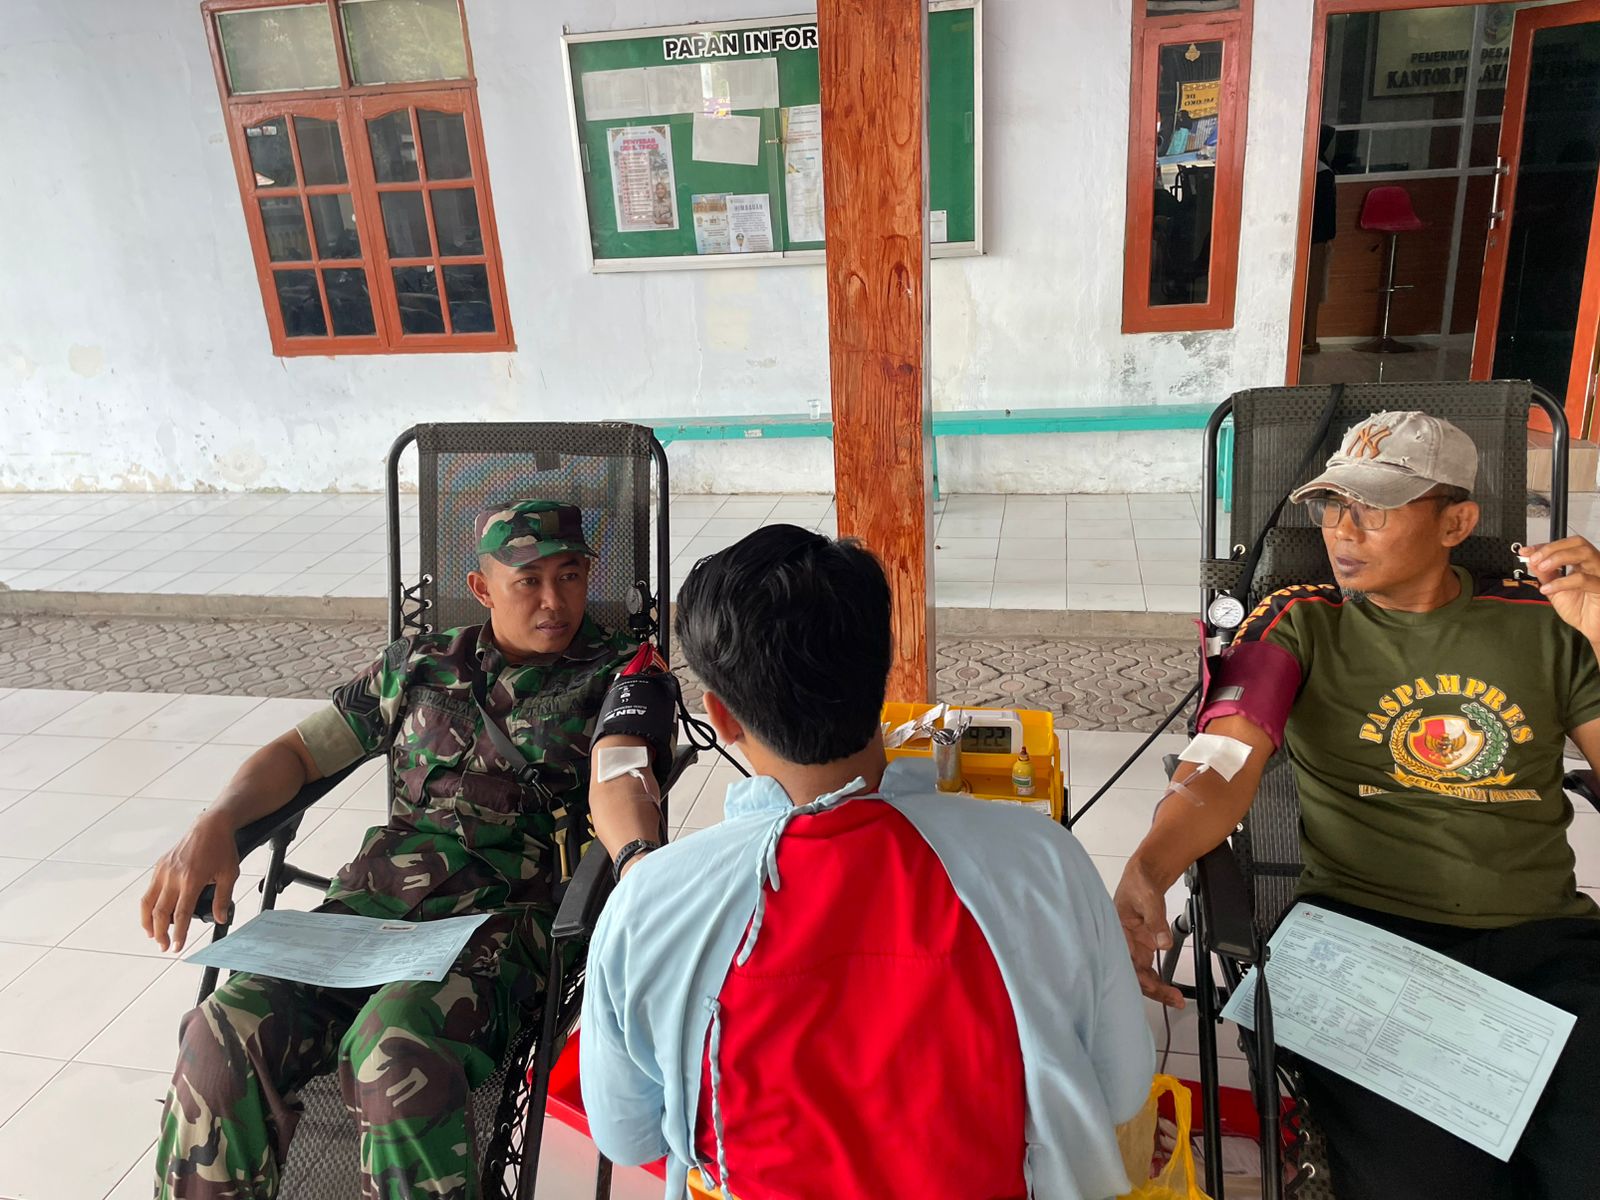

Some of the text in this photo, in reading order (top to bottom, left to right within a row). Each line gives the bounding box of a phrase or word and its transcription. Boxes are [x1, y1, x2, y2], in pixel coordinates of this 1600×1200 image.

[664, 33, 739, 60] PAPAN
[1411, 49, 1470, 63] PEMERINTA
[1386, 67, 1451, 89] KANTOR
[1359, 673, 1534, 744] PASPAMPRES
[1407, 775, 1441, 791] SETIA
